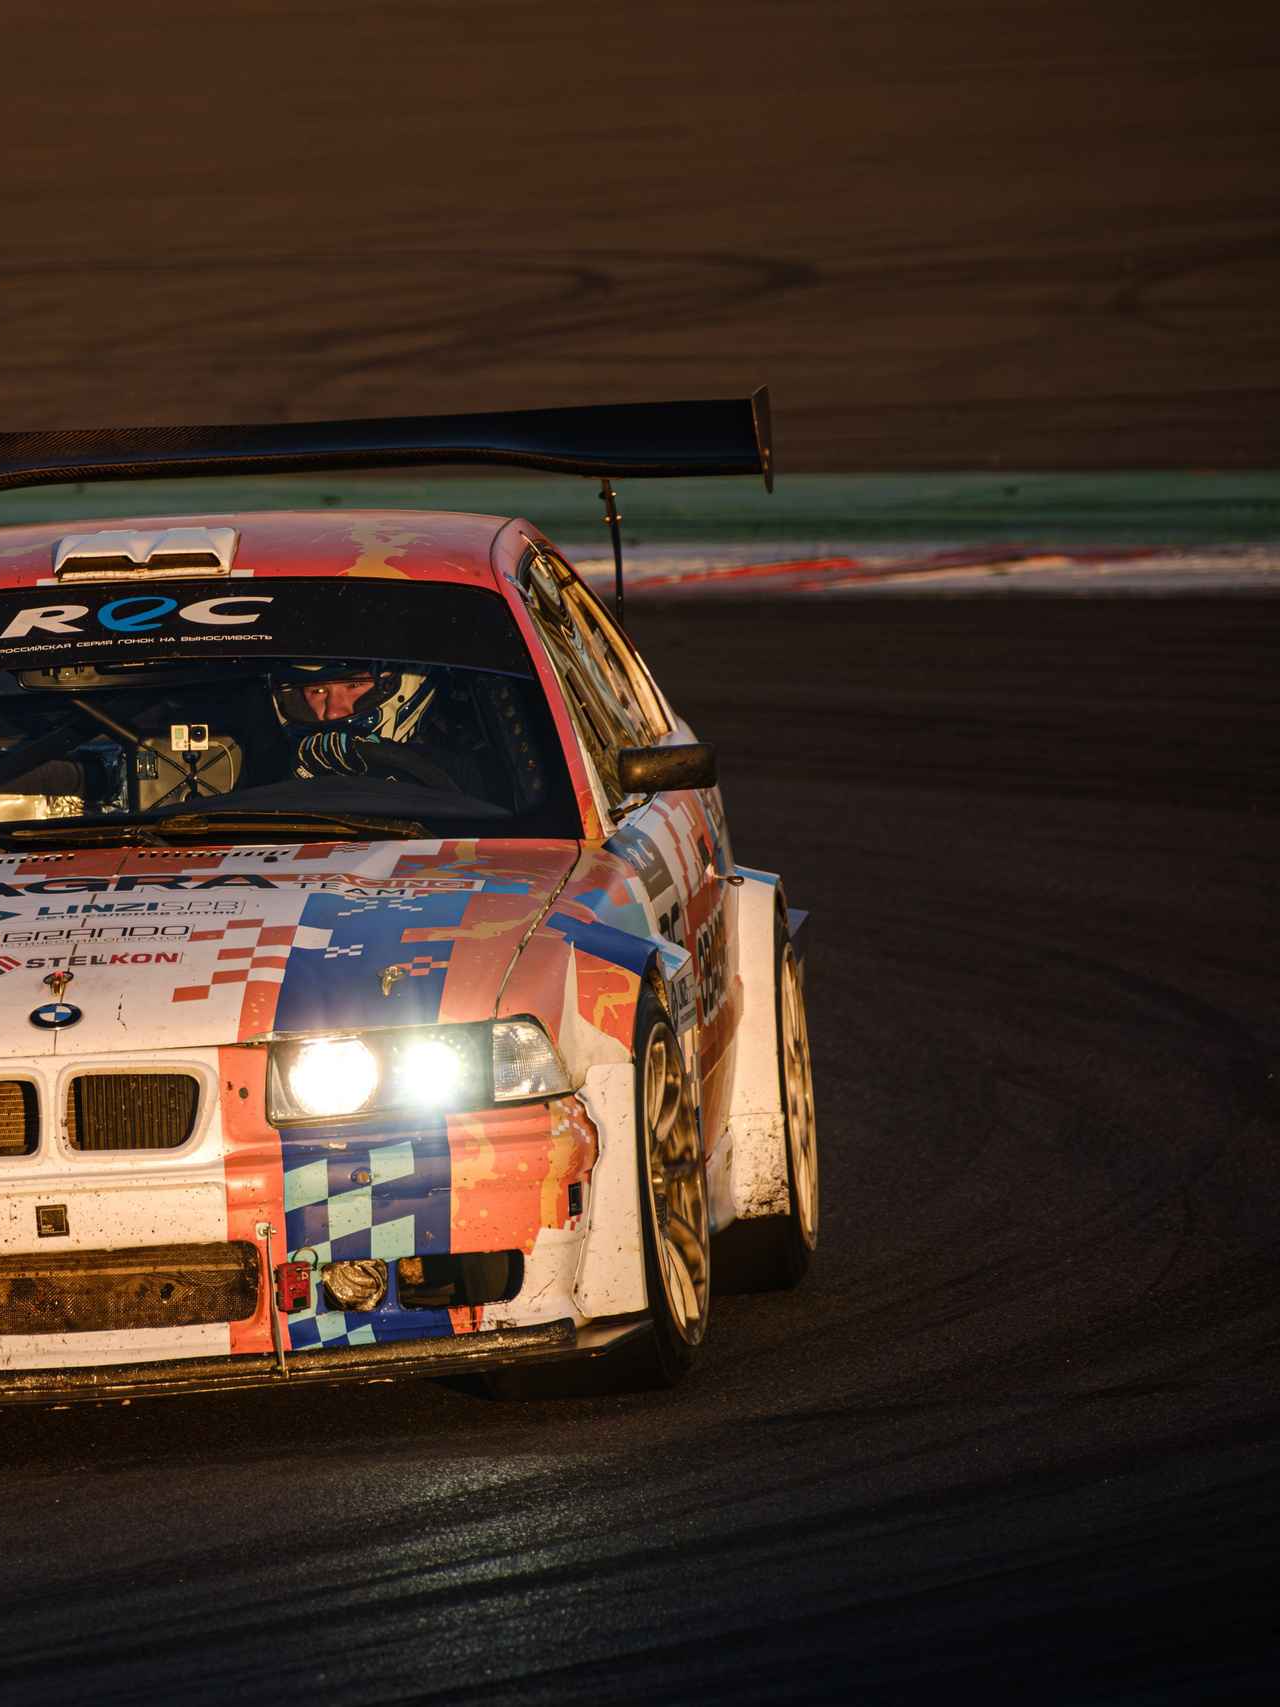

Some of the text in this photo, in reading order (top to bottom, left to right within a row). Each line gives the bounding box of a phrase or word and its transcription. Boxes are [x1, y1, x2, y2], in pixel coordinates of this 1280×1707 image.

[76, 639, 113, 648] СЕРИЯ
[117, 637, 155, 645] ГОНОК
[180, 634, 273, 642] ВЫНОСЛИВОСТЬ
[297, 874, 466, 889] RACING
[293, 882, 407, 896] TEAM
[24, 952, 180, 969] STELKON
